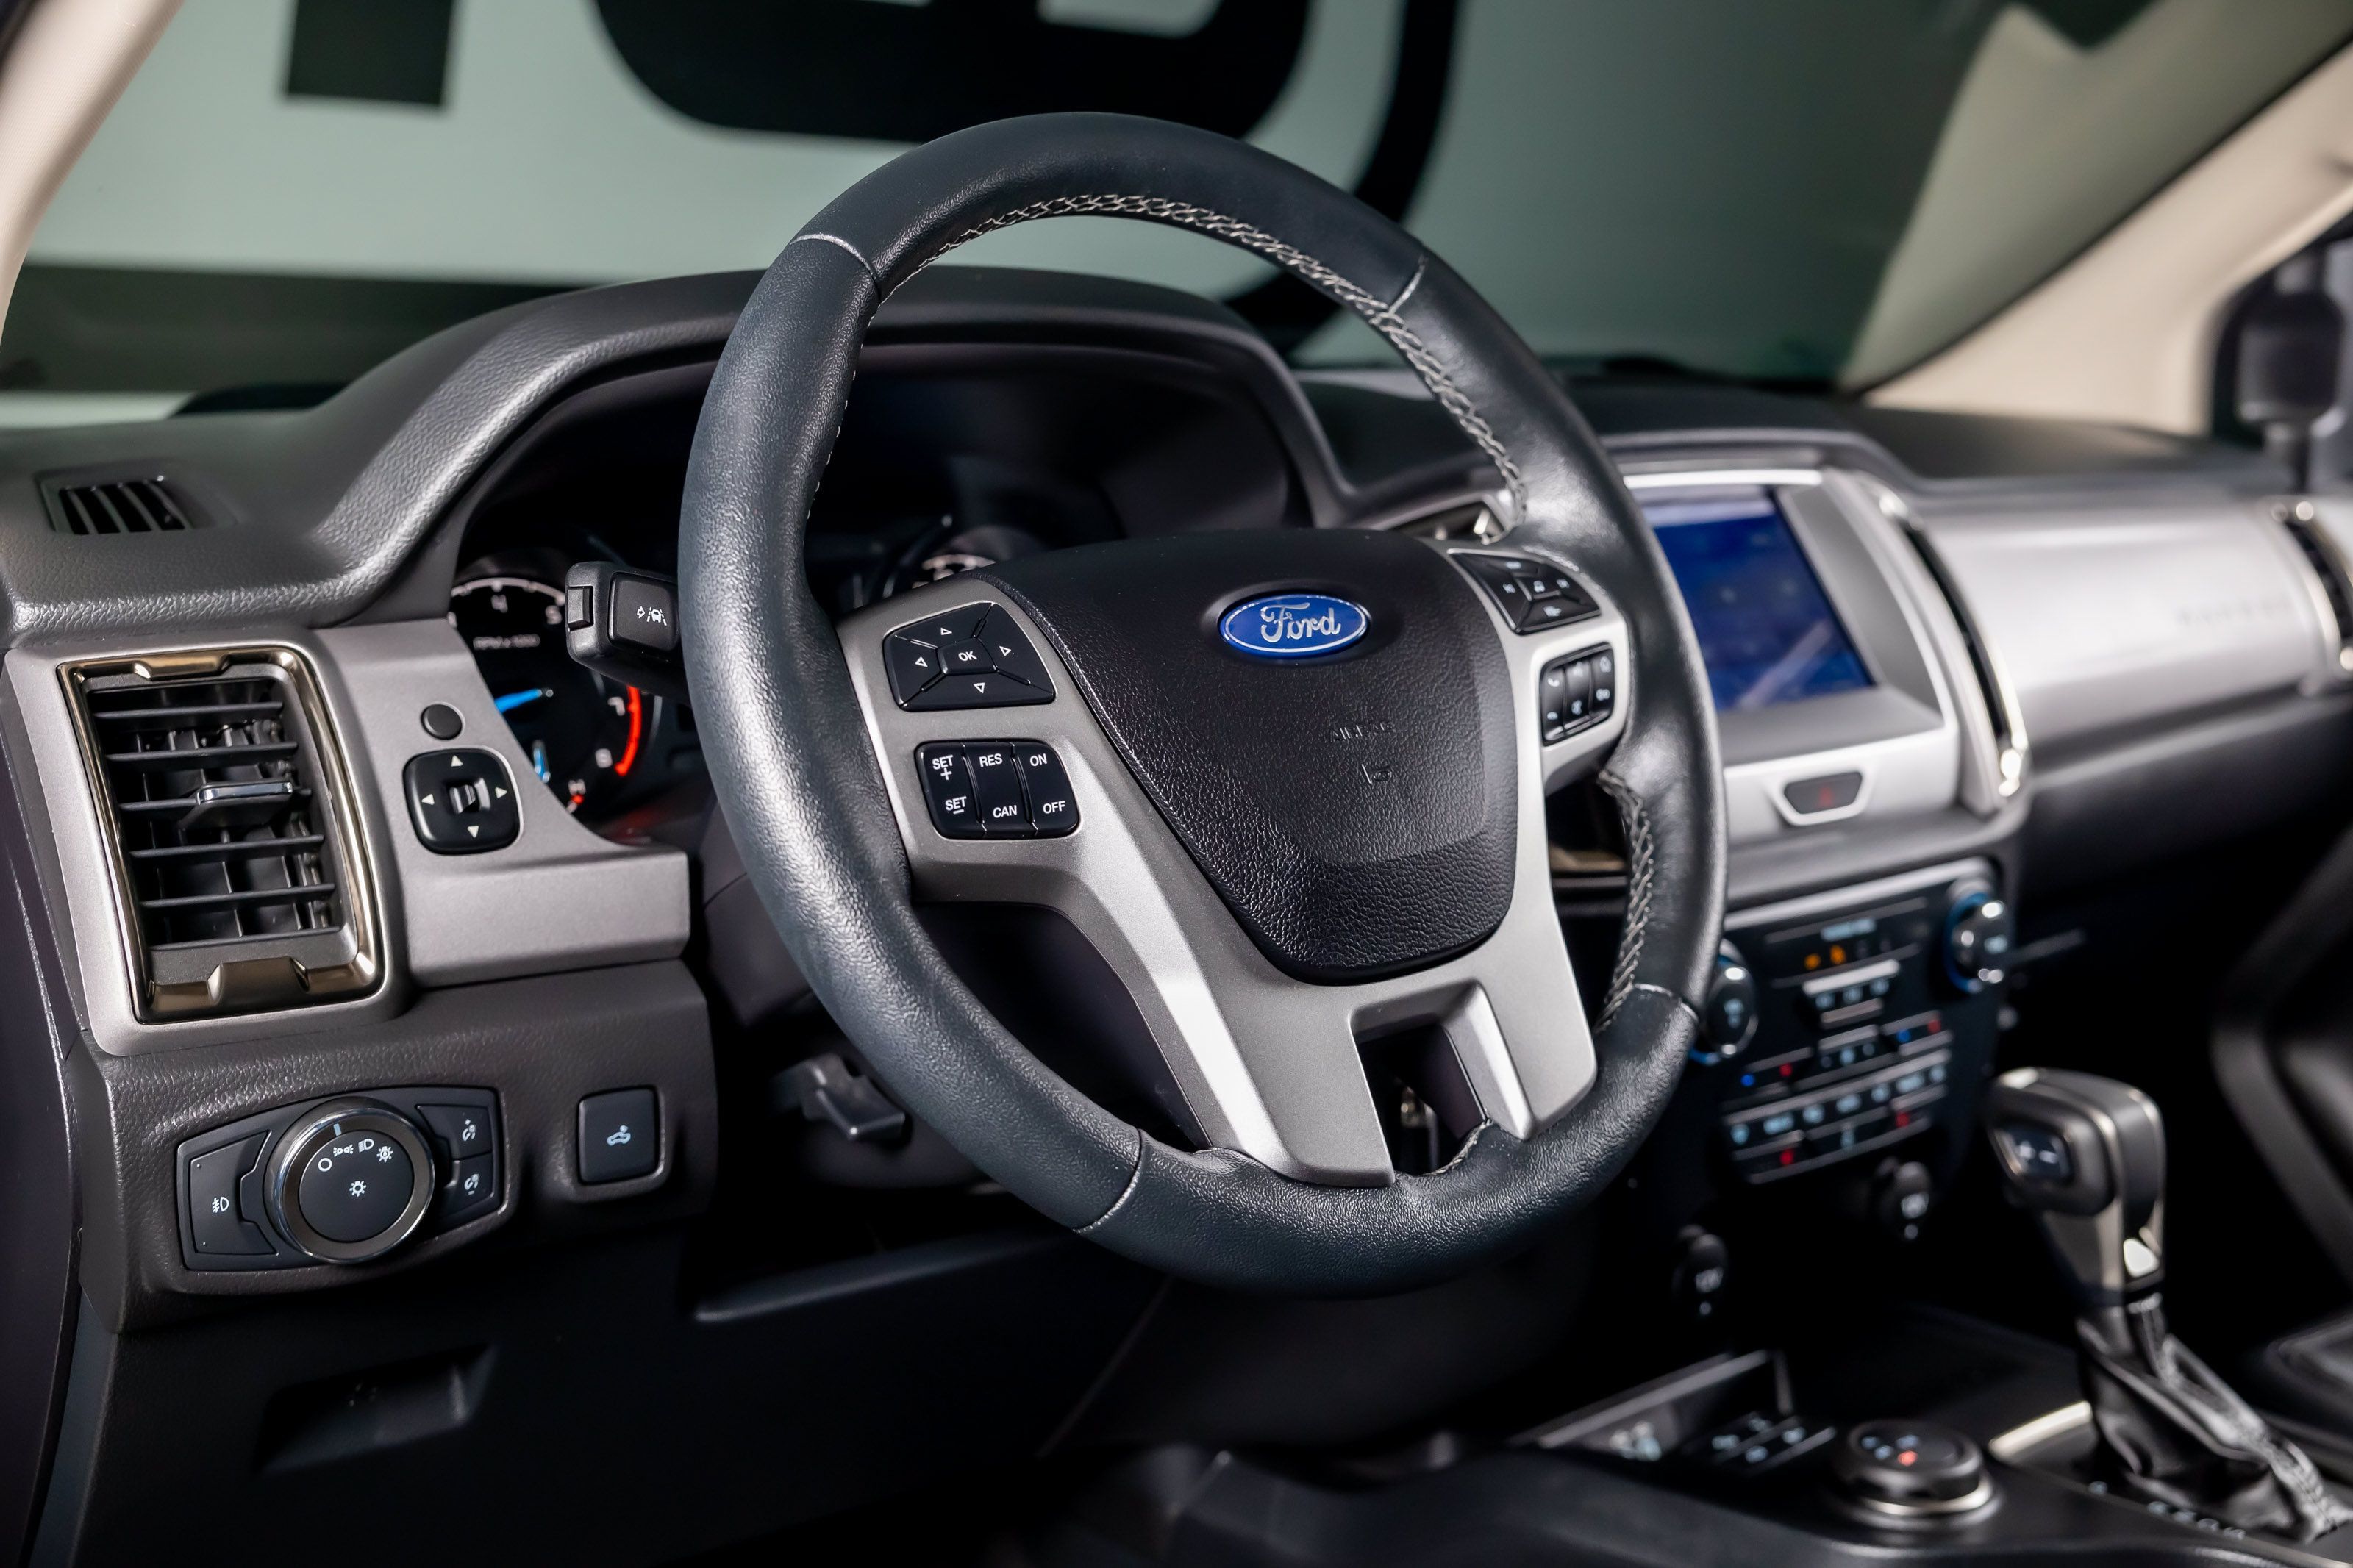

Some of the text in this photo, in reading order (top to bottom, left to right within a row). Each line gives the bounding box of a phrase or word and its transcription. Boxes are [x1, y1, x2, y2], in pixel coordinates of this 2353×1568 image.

[1260, 601, 1342, 644] Ford
[958, 651, 977, 662] OK
[932, 754, 954, 770] SET
[979, 753, 1003, 768] RES
[1029, 753, 1048, 767] ON
[945, 795, 967, 812] SET
[1043, 800, 1065, 815] OFF
[993, 804, 1018, 819] CAN
